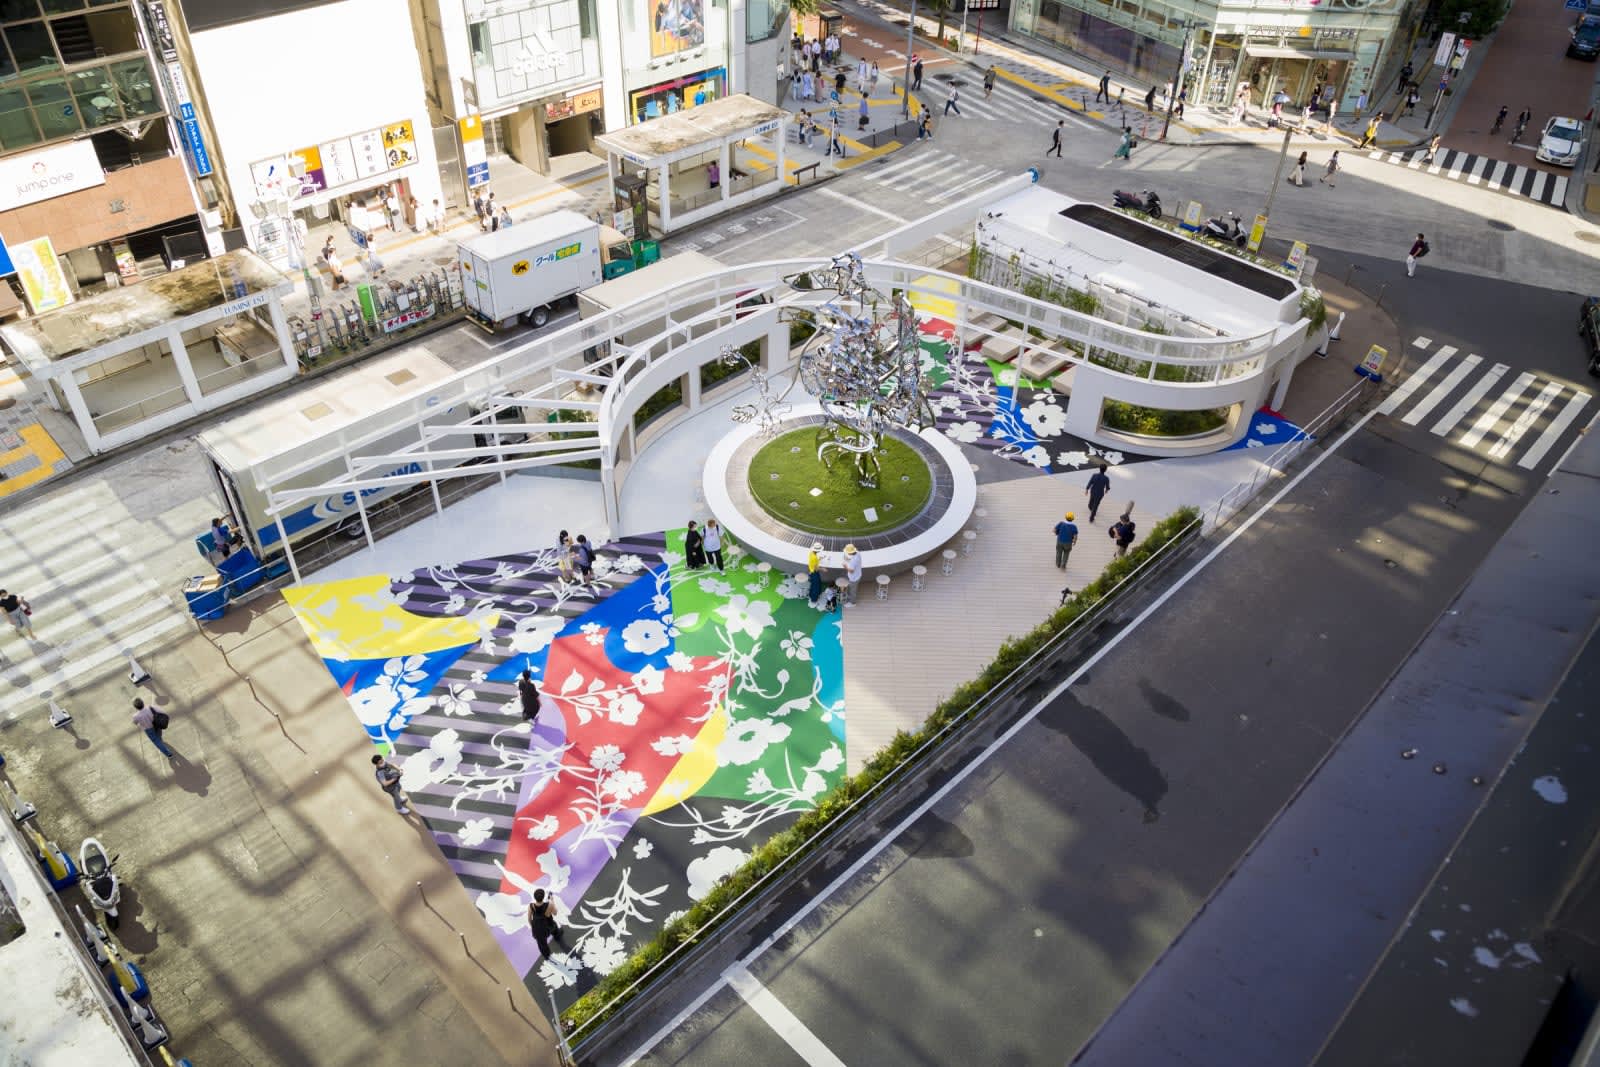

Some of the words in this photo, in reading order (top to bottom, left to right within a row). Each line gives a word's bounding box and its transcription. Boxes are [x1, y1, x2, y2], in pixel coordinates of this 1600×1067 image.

[511, 51, 569, 77] adidas
[16, 179, 49, 197] jump
[49, 172, 75, 186] one
